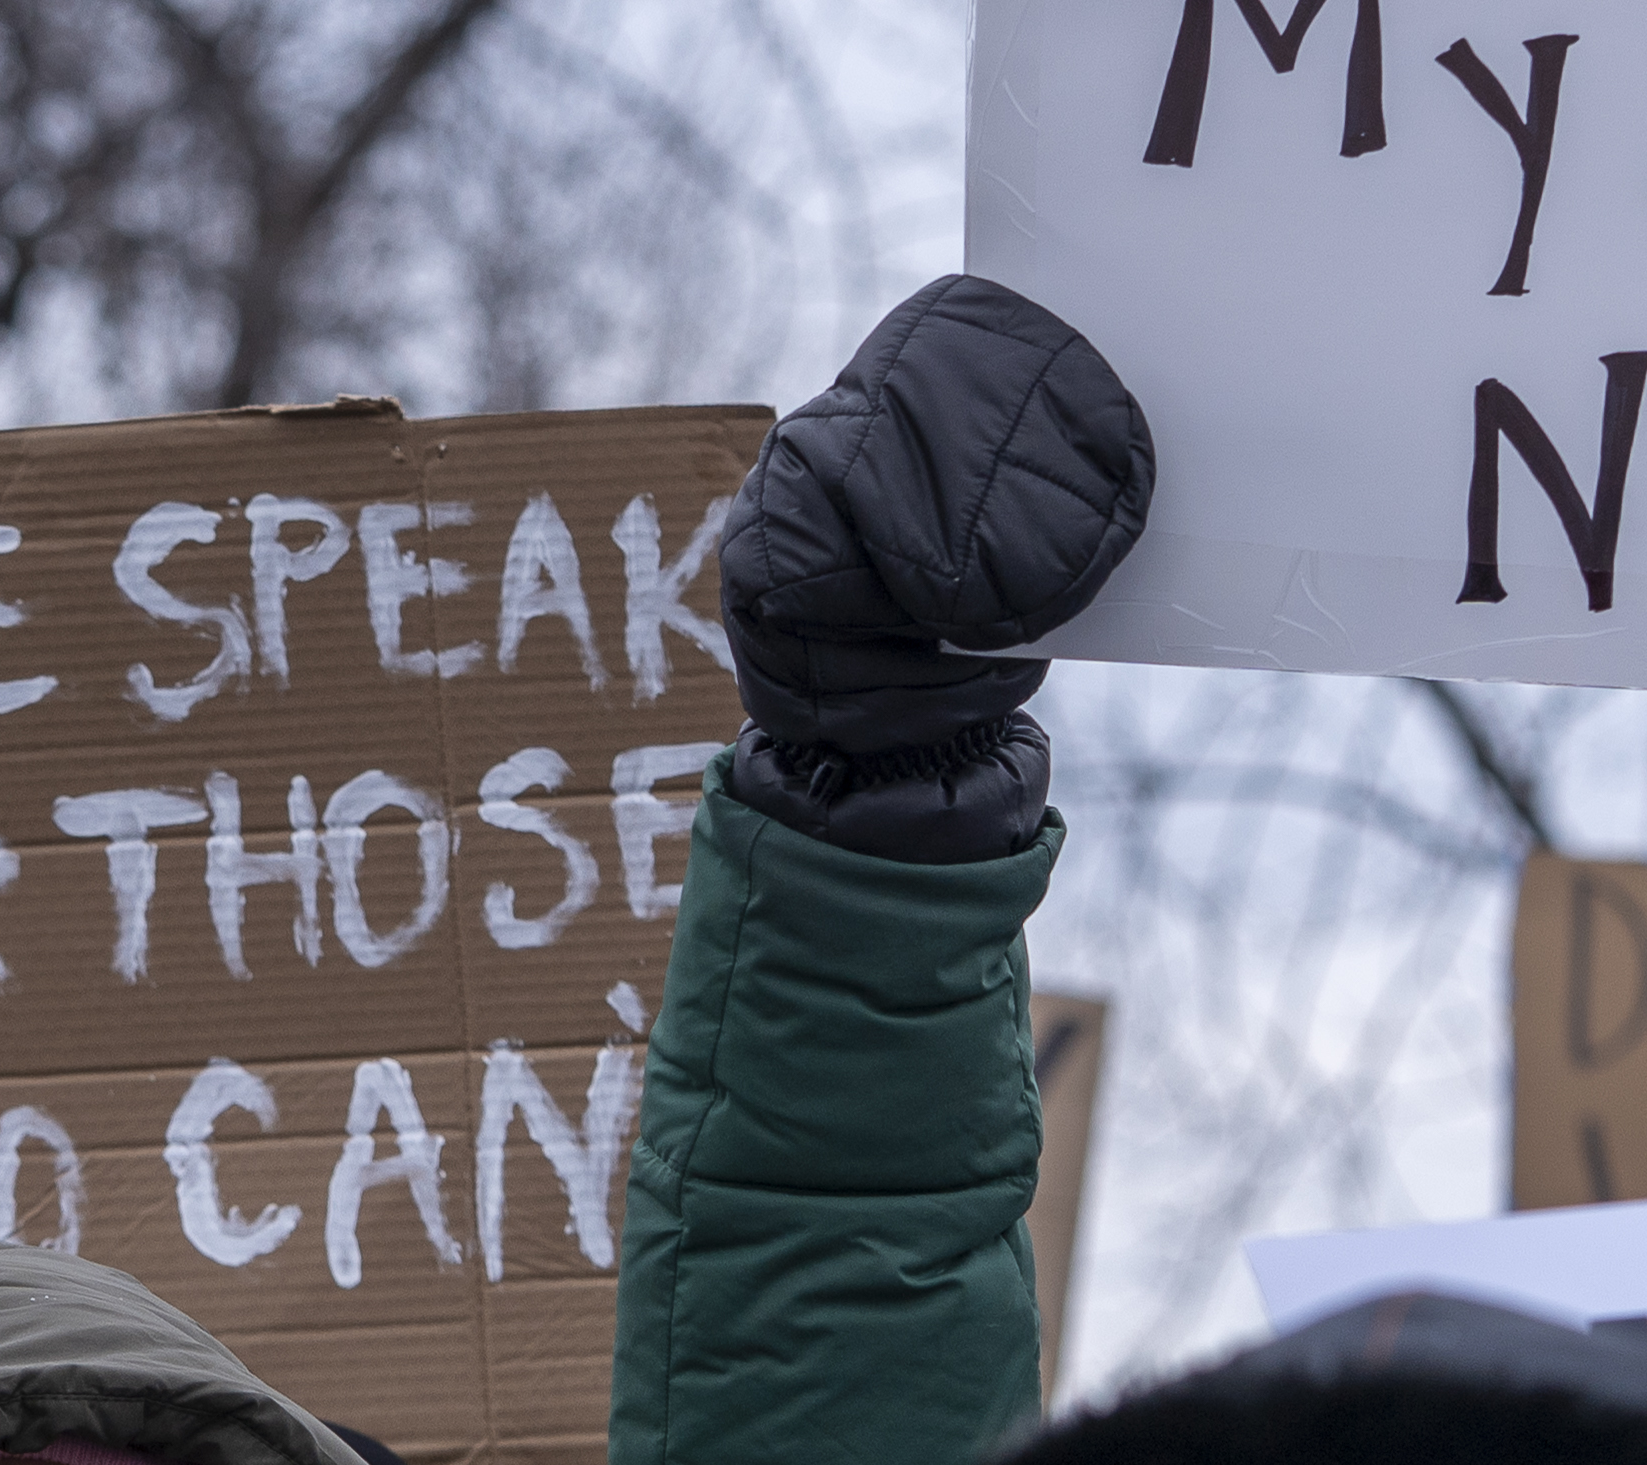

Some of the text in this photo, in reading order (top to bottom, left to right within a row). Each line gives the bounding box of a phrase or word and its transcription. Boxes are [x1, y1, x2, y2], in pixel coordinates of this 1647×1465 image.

[113, 492, 738, 723] SPEAK
[52, 741, 725, 984] THOSE
[163, 979, 648, 1288] CAN'
